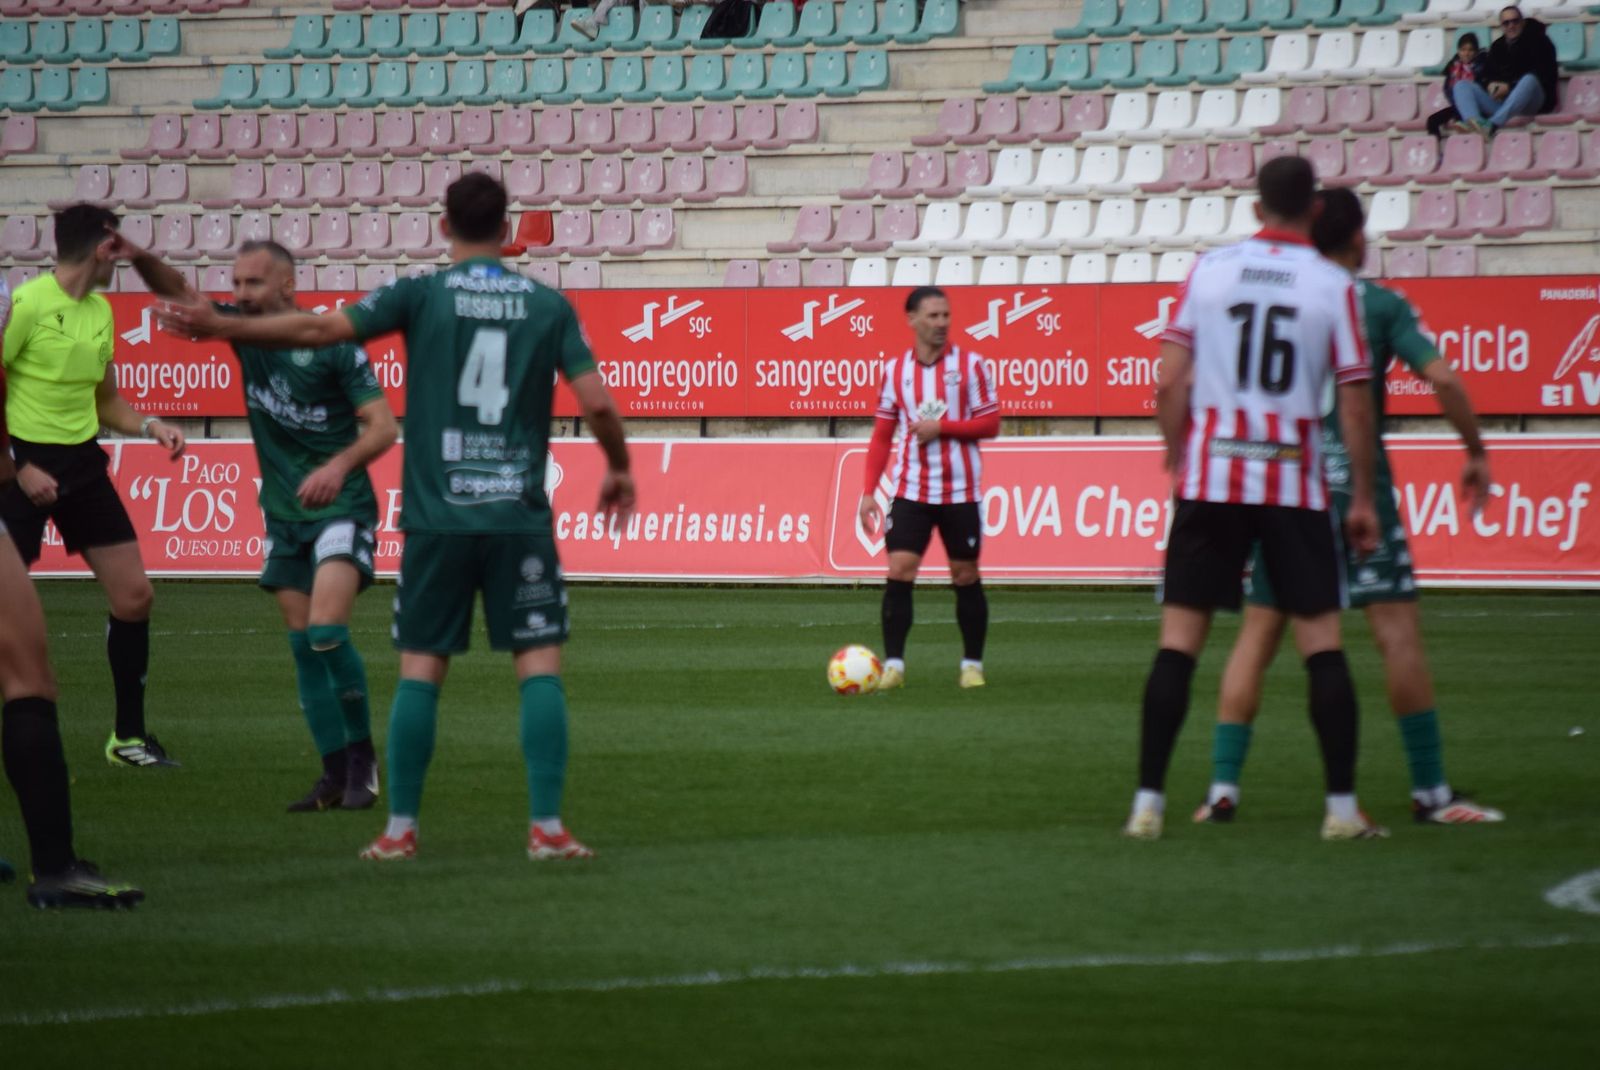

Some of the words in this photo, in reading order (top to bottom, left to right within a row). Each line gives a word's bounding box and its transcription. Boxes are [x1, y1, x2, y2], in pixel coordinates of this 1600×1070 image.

[688, 316, 712, 338] sgc
[849, 315, 874, 337] sgc
[1036, 312, 1061, 336] sgc
[1229, 303, 1297, 394] 16
[1424, 325, 1530, 373] cicla
[114, 355, 231, 398] ngregorio
[458, 328, 509, 425] 4
[597, 352, 738, 397] sangregorio
[755, 351, 885, 397] sangregori
[984, 350, 1089, 396] regorio
[1385, 377, 1437, 395] VEHÍCUL
[630, 401, 705, 410] CONSTRUCCION
[790, 400, 867, 410] CONSTRUCCION
[1001, 400, 1053, 410] TRUCCION
[181, 455, 240, 484] PAGO
[556, 504, 811, 550] casqueriasusi.es
[982, 485, 1063, 537] OVA
[1473, 482, 1592, 551] Chef
[165, 536, 219, 559] QUESO
[222, 540, 242, 557] DE
